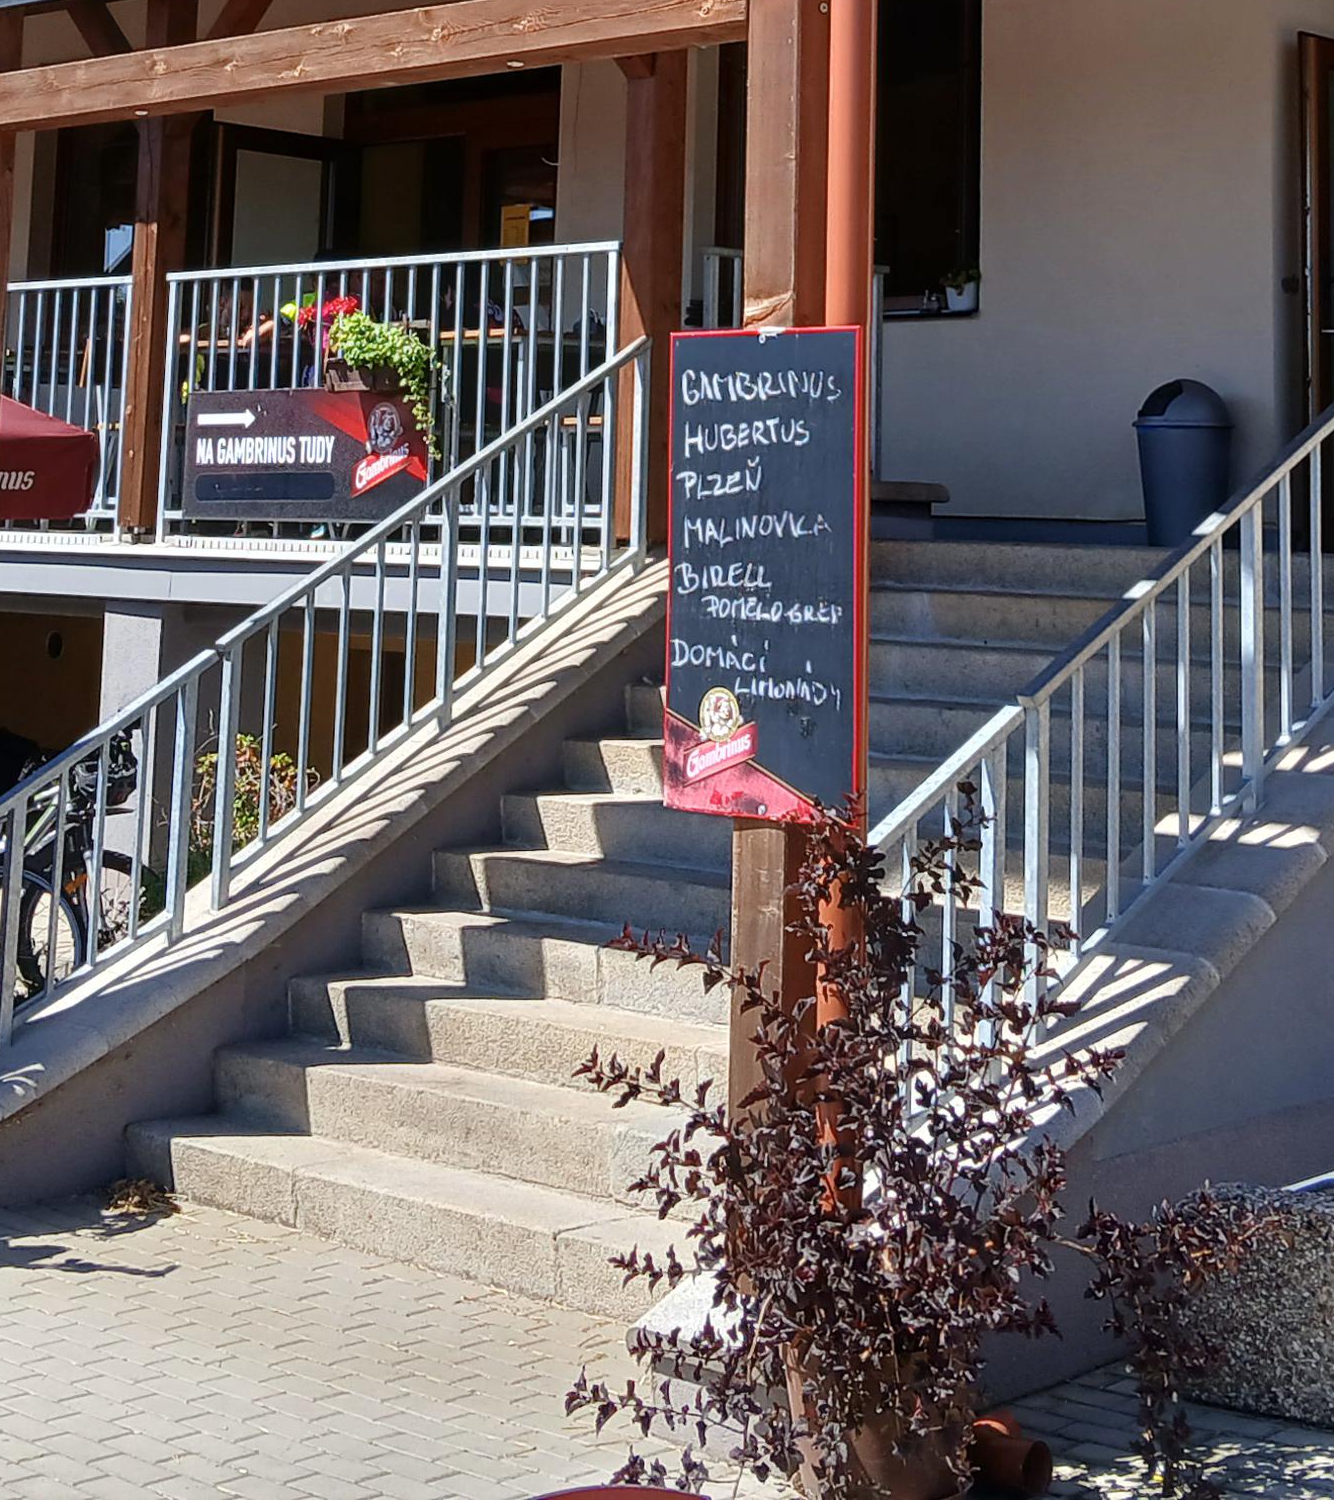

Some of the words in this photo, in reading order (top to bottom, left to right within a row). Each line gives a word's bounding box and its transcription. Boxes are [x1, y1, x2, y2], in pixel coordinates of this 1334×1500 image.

[681, 369, 843, 405] GAMBRINUS
[196, 437, 214, 465] NA
[217, 436, 296, 465] GAMBRINUS
[299, 435, 335, 464] TUDY
[684, 417, 810, 459] HUBERTUS
[676, 456, 762, 500] PLZEŇ
[684, 510, 832, 549] MALINOVKA
[670, 635, 771, 673] DOMÁCÍ
[686, 733, 753, 778] Gambrinus
